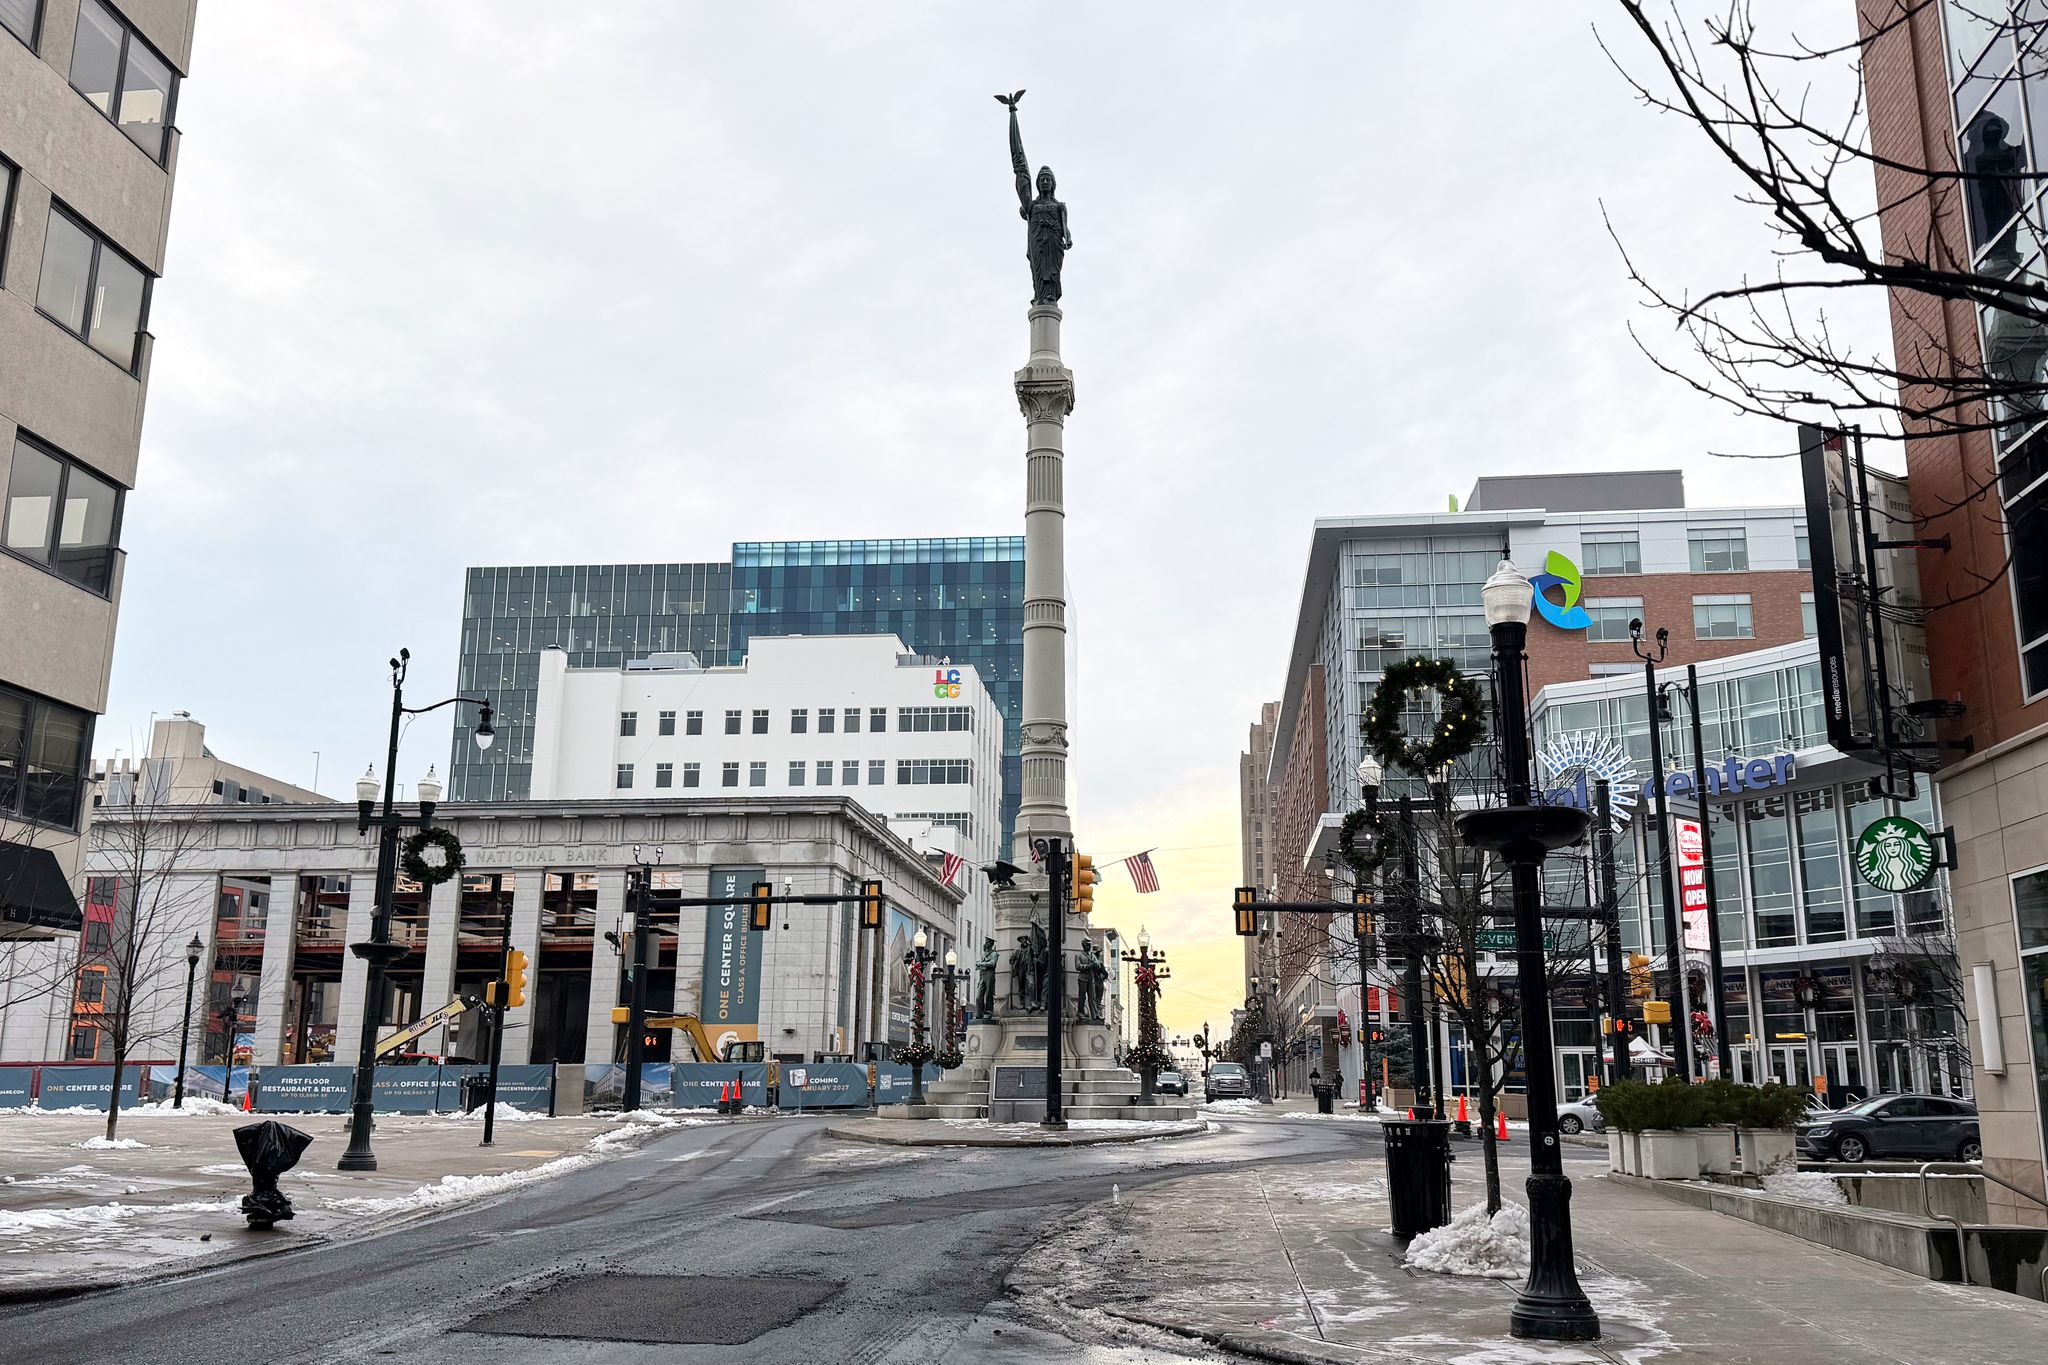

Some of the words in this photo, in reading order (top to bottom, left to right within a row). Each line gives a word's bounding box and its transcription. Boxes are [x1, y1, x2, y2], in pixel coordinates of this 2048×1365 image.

[1830, 656, 1842, 714] mediaresources
[1644, 753, 1794, 799] center
[476, 849, 556, 864] NATIONAL
[566, 847, 608, 863] BANK
[1684, 868, 1703, 886] NOW
[1685, 888, 1707, 906] OPEN
[1474, 934, 1516, 944] SVEN
[737, 976, 745, 1005] CLASS
[741, 892, 750, 933] BUILDIG
[721, 933, 733, 986] CENTER
[1776, 979, 1794, 989] NEW
[1827, 976, 1852, 986] NEWS
[719, 990, 729, 1020] ONE
[1628, 1020, 1633, 1032] 6
[652, 1036, 657, 1046] 6
[1379, 1032, 1384, 1041] 6
[66, 1084, 97, 1092] CENTER
